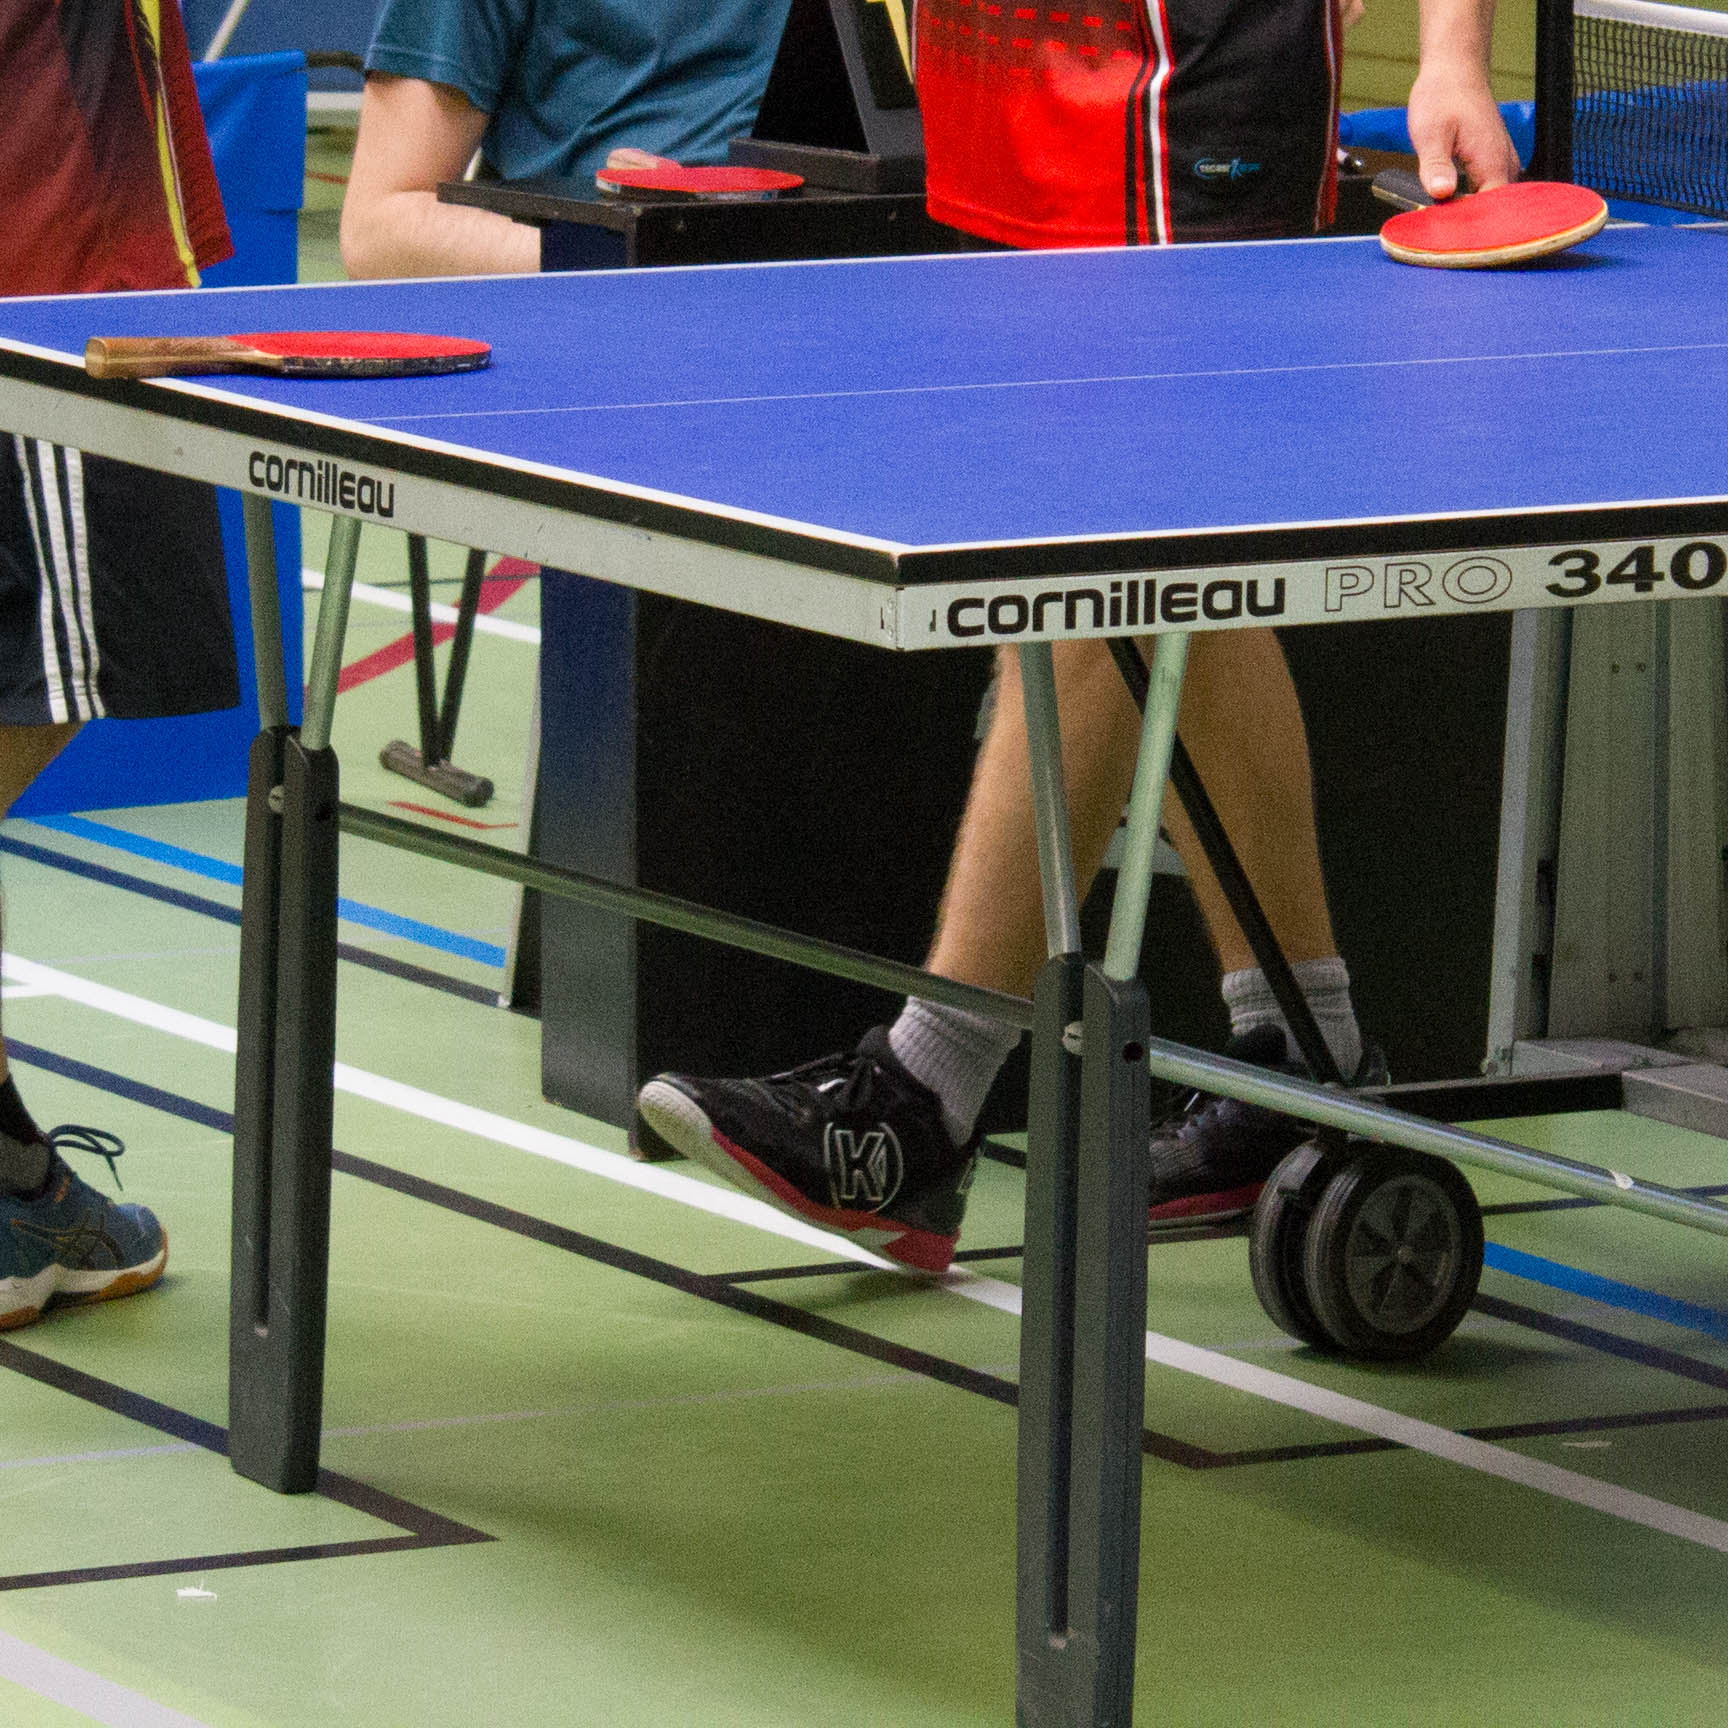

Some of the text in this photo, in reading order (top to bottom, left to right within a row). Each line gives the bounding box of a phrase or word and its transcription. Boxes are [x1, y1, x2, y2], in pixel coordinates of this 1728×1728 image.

[248, 450, 395, 518] cornilleau
[946, 541, 1728, 638] cornilleau PRO 340
